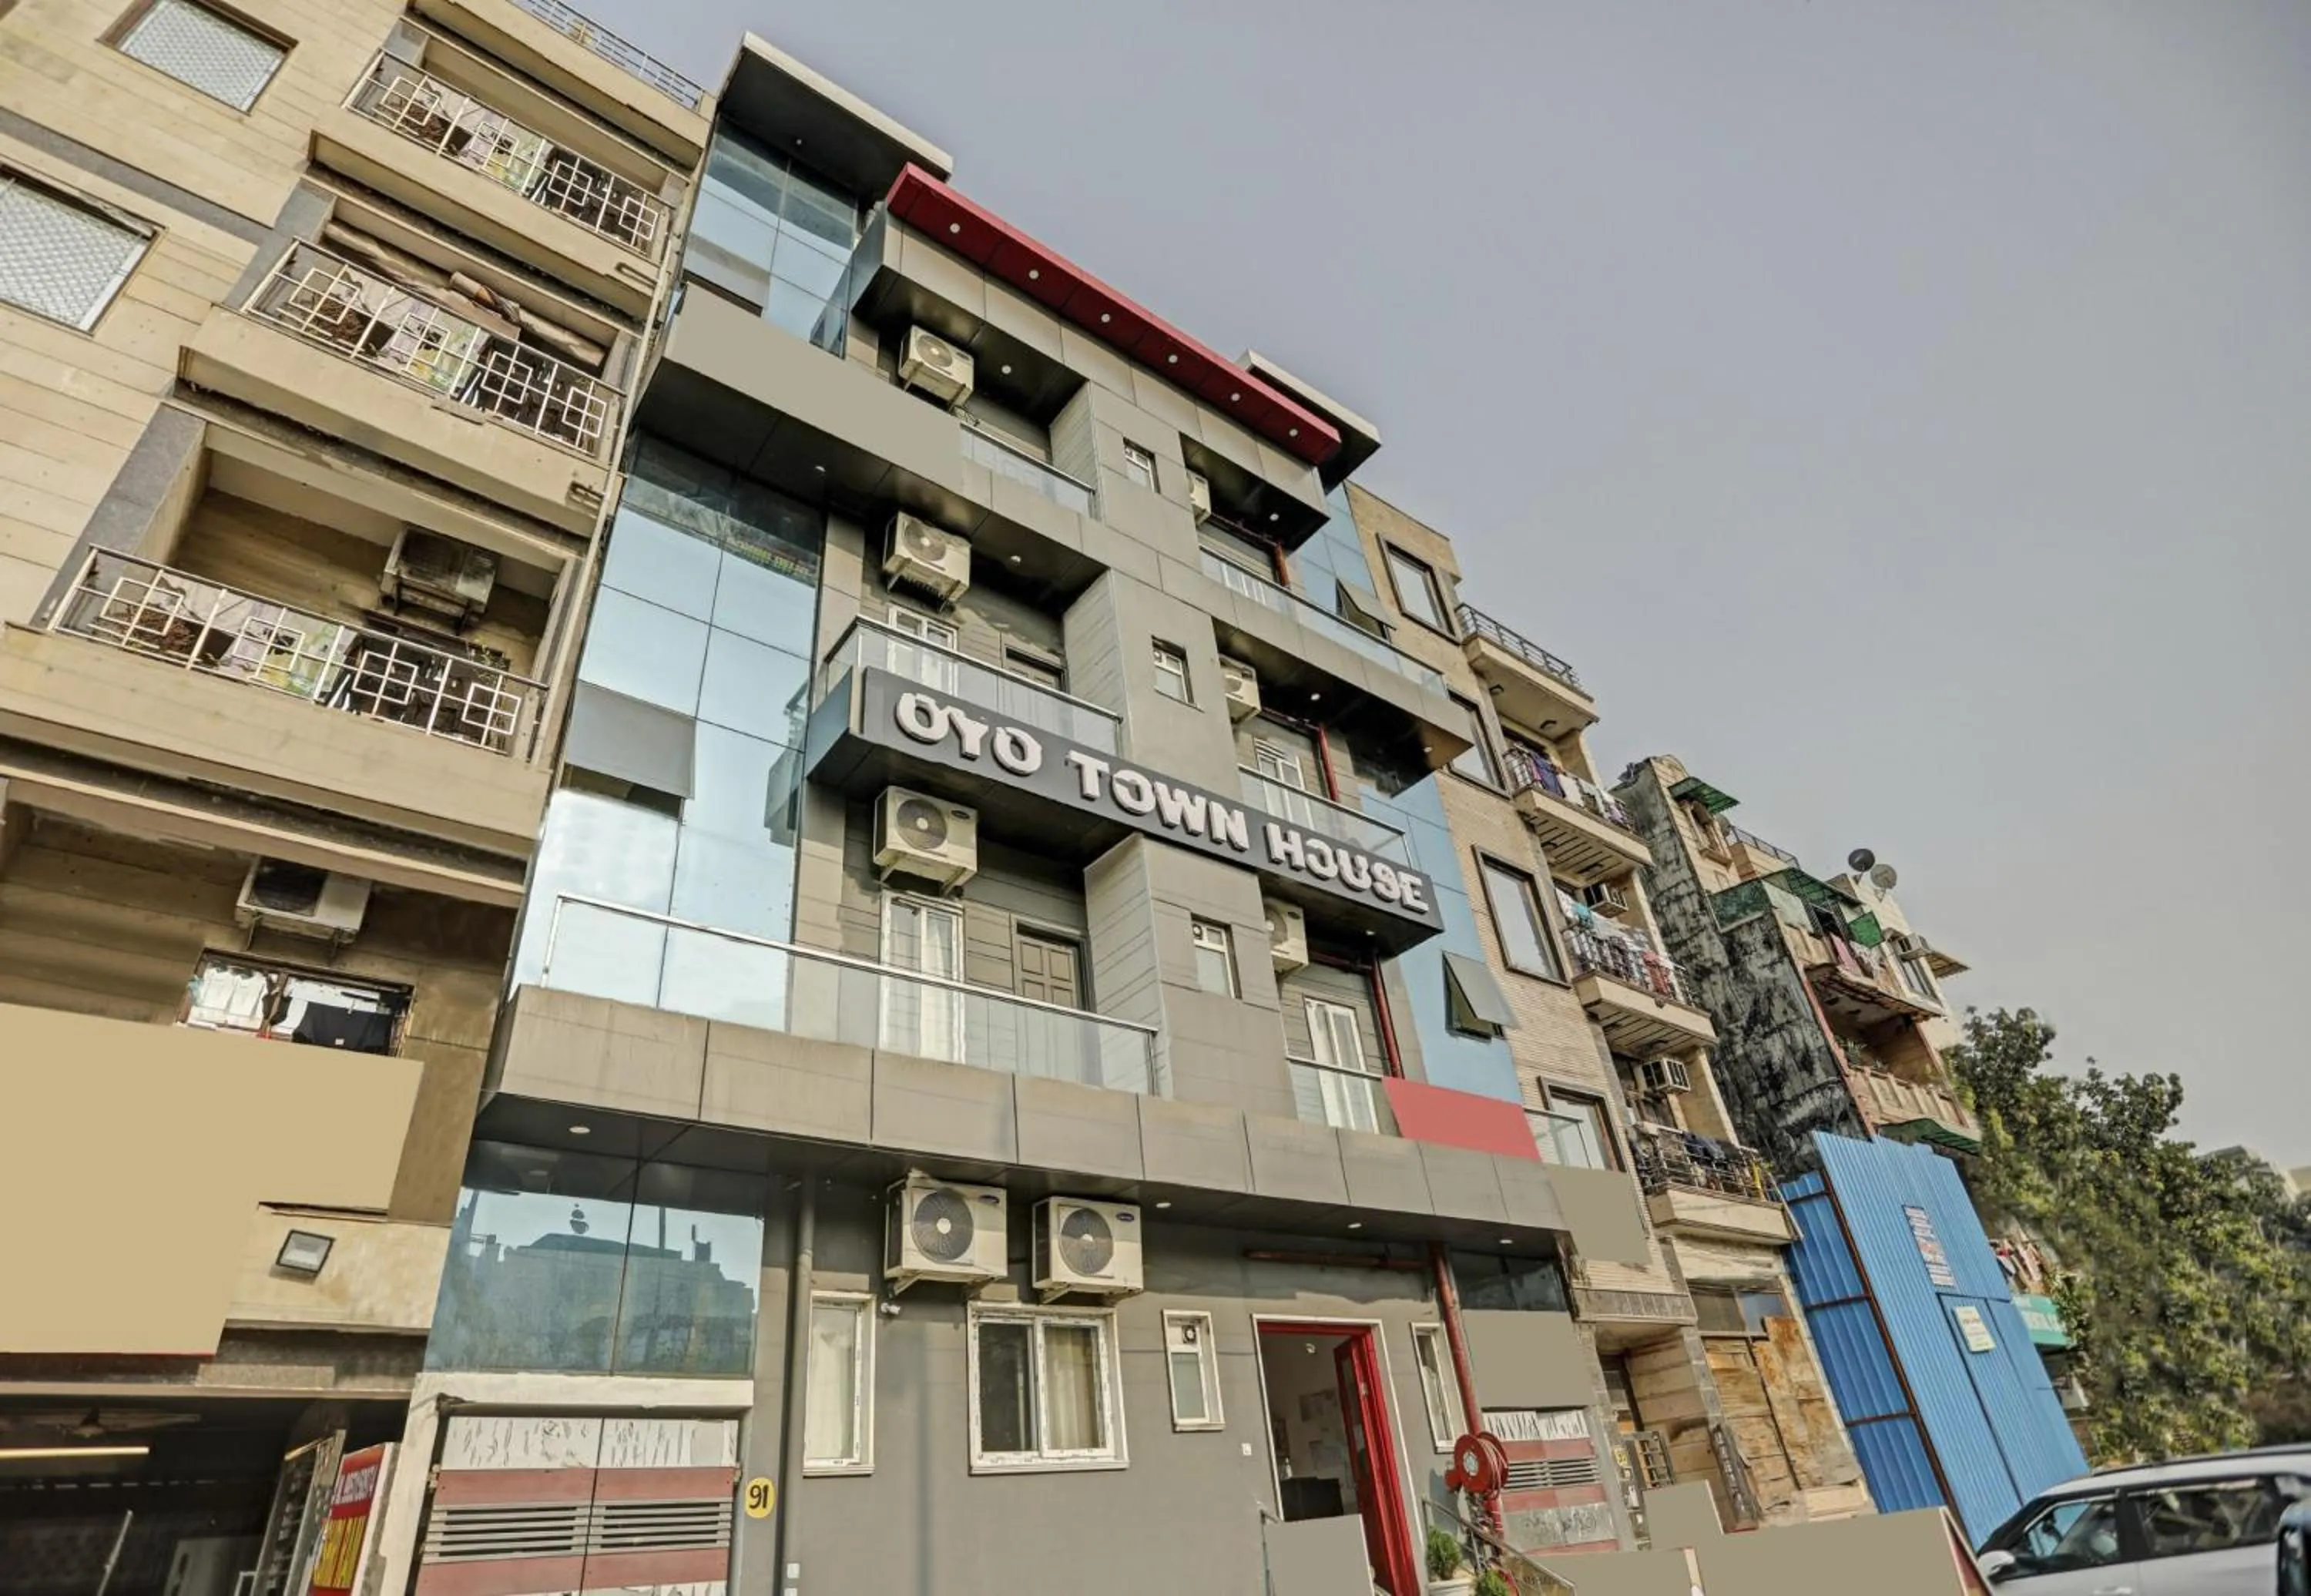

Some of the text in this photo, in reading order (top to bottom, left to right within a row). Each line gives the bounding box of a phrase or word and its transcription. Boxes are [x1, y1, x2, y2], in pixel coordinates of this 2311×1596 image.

[895, 692, 1430, 913] OYO TOWN HOUSE
[749, 1484, 770, 1510] 91
